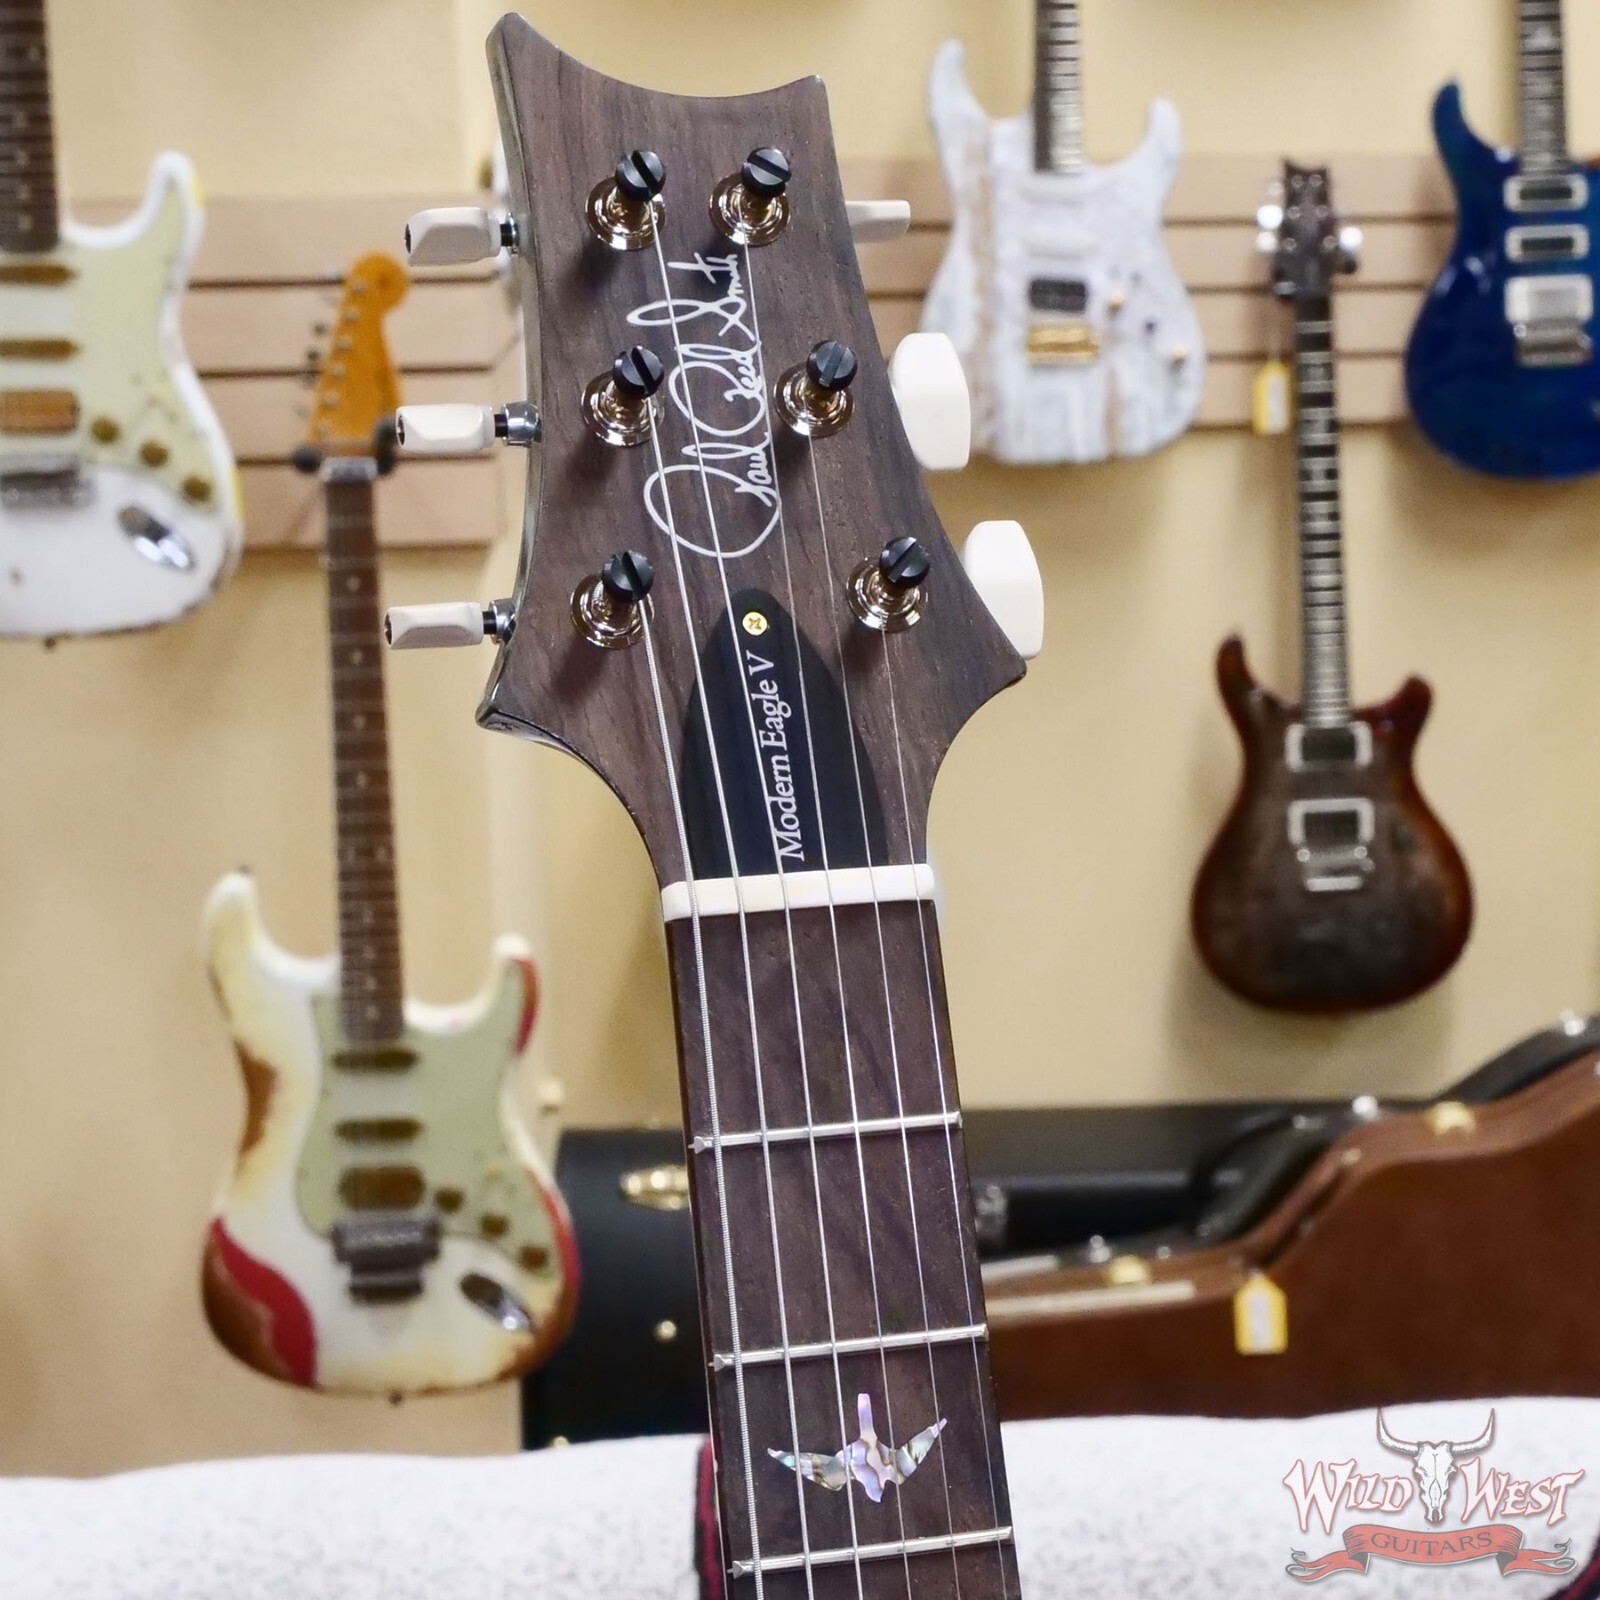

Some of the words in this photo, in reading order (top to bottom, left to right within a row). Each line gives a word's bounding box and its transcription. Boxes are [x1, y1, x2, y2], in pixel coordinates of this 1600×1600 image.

[745, 649, 775, 677] V
[750, 678, 792, 751] Eagle
[768, 754, 805, 862] Modern
